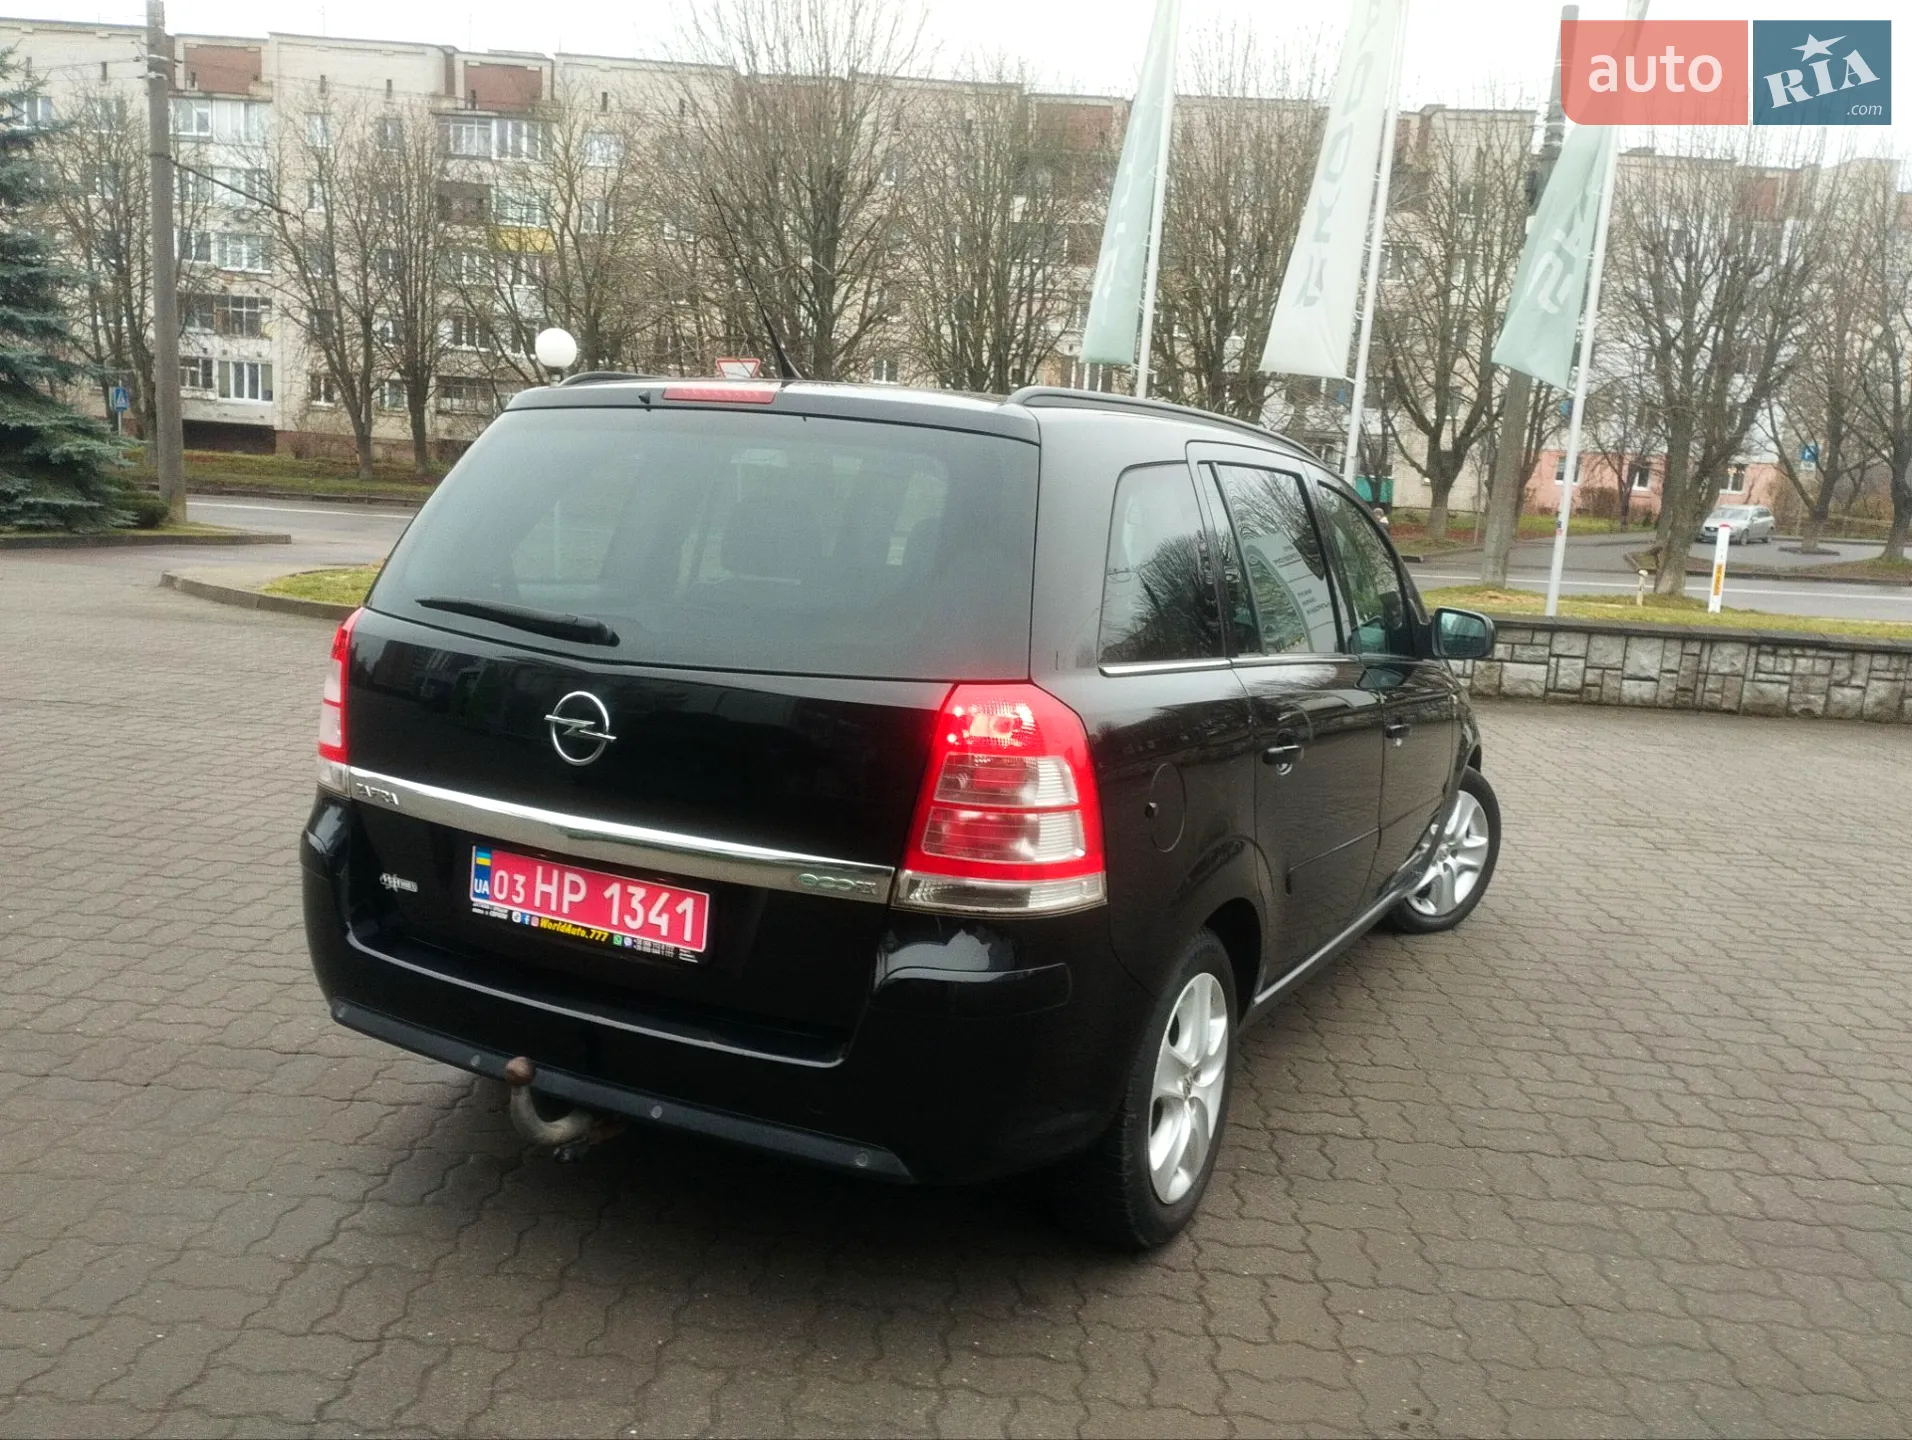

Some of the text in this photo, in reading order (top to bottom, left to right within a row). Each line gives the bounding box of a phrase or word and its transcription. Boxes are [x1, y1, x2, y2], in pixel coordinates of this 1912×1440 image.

[474, 878, 490, 895] UA
[493, 865, 694, 942] 03 HP 1341
